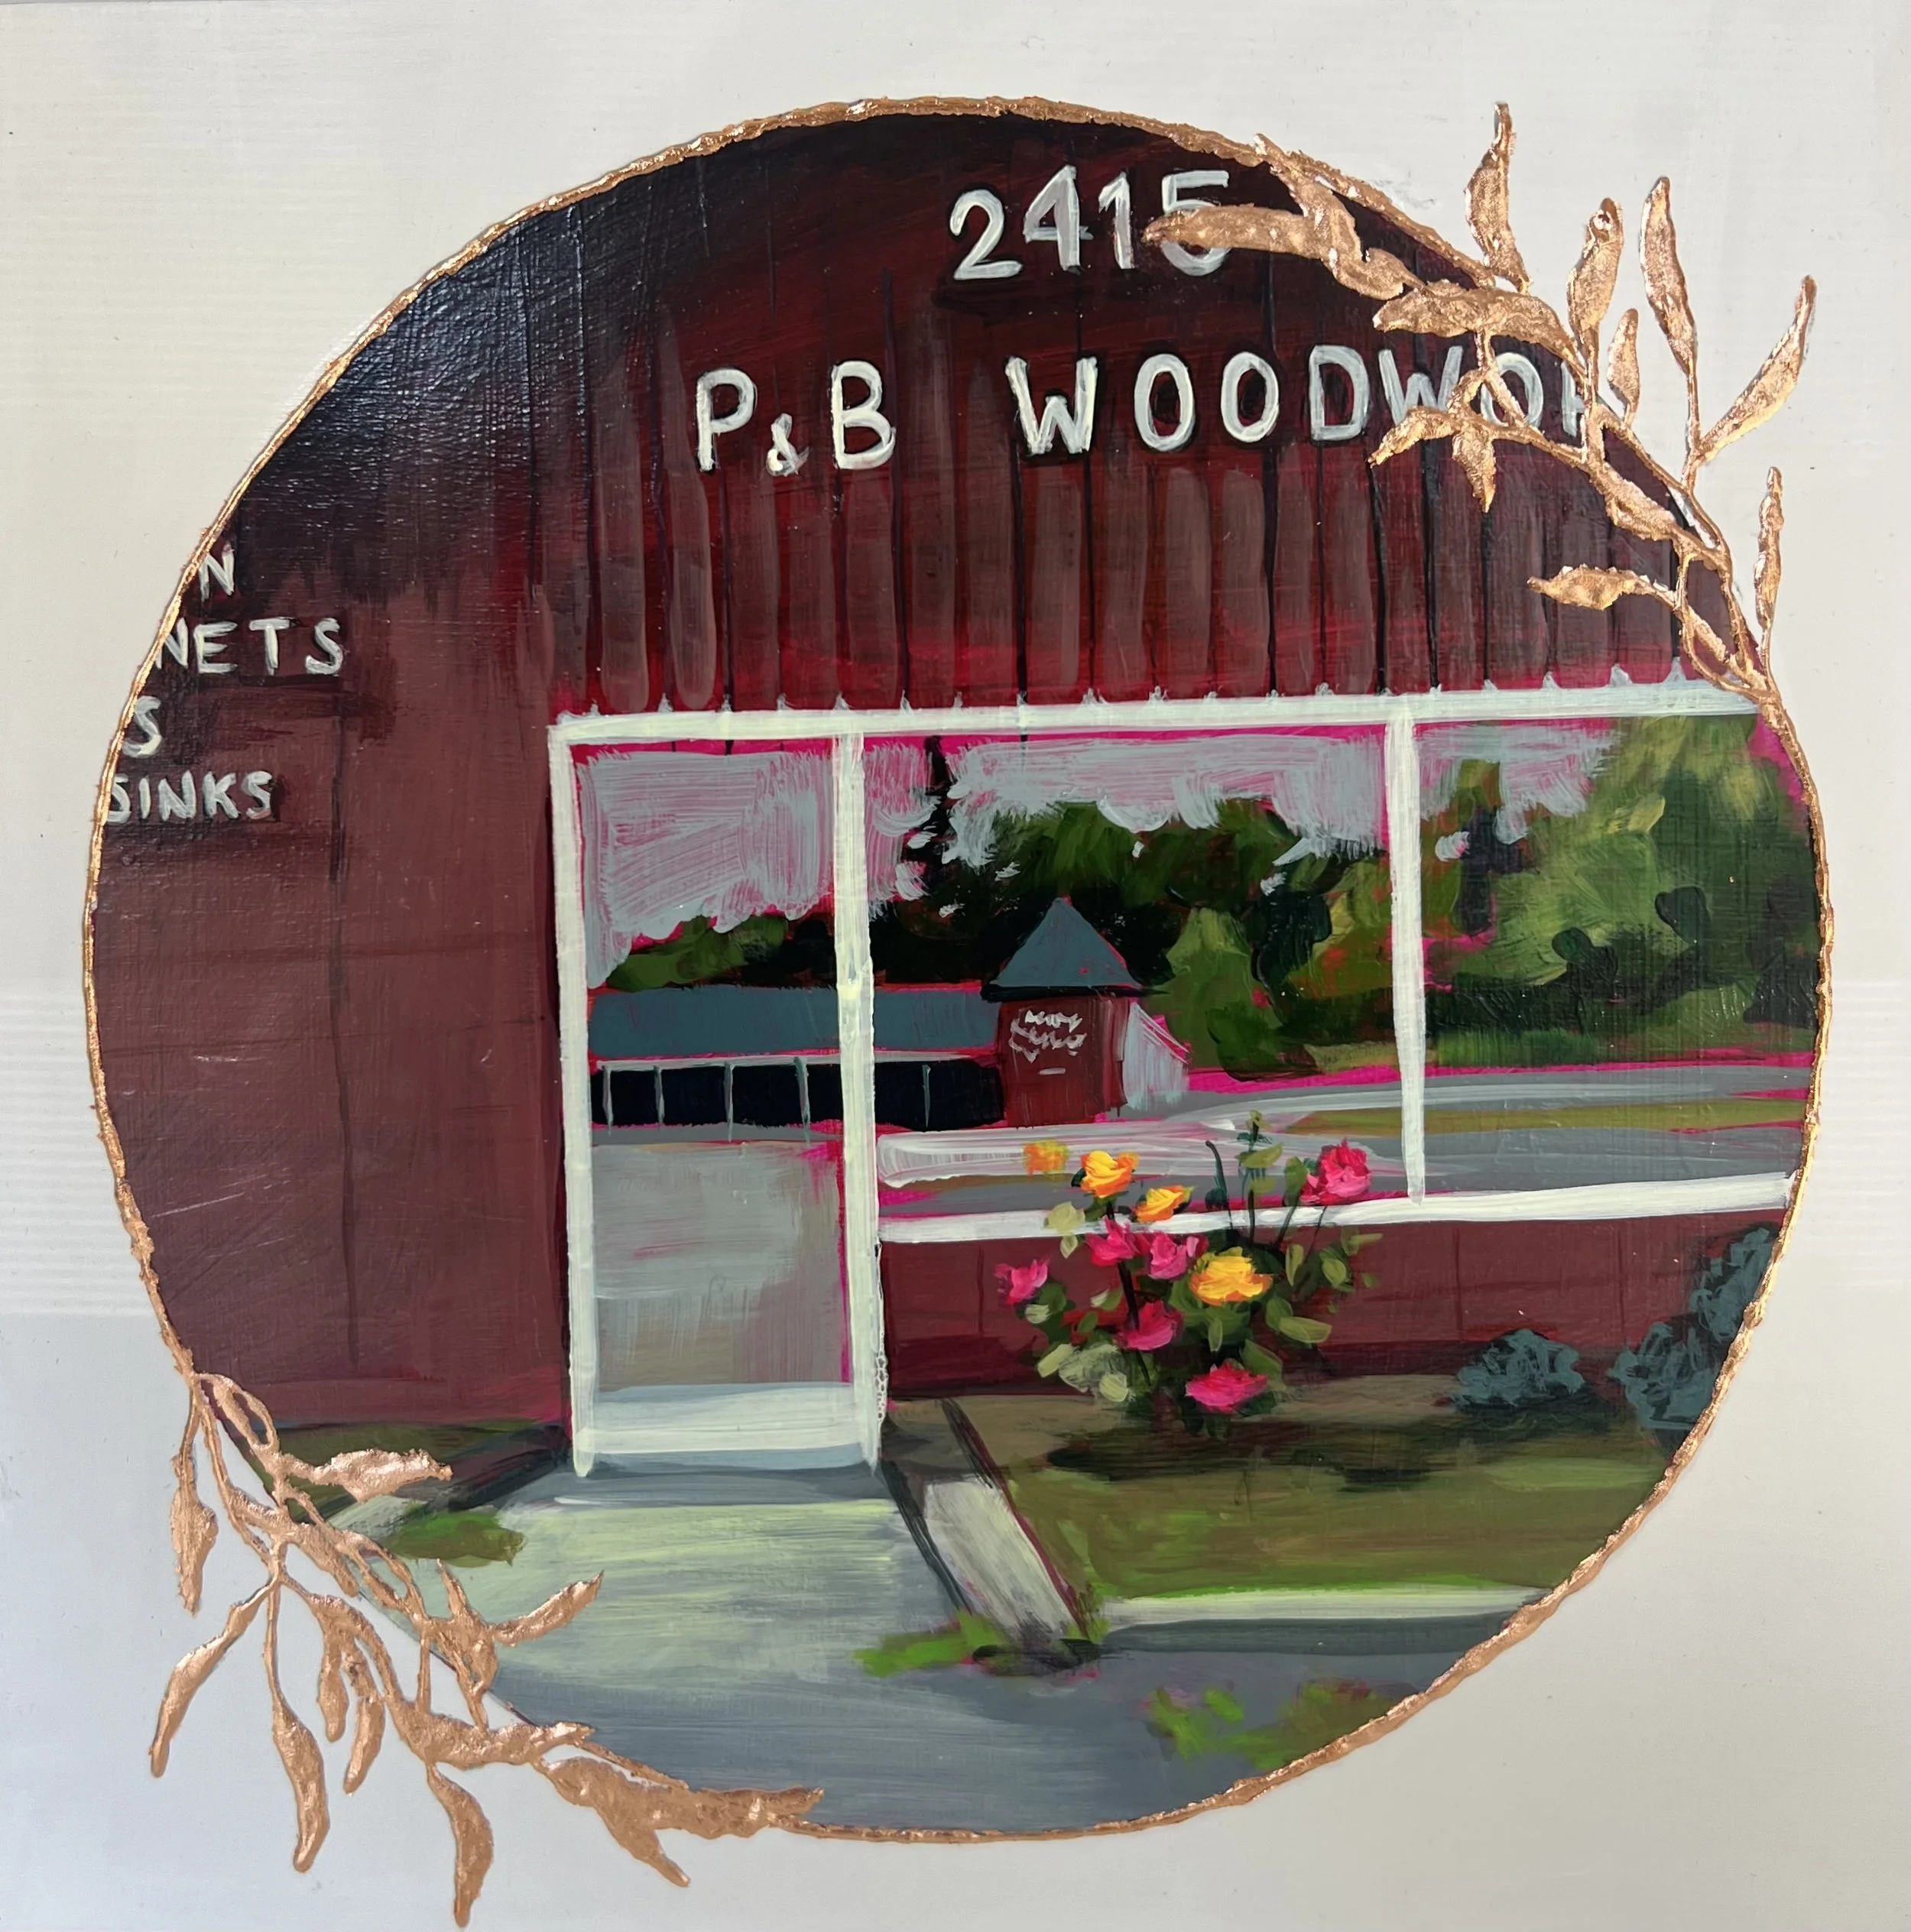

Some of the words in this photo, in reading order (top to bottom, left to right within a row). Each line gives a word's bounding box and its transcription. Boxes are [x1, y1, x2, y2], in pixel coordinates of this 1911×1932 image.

[949, 164, 1231, 280] 2415
[692, 368, 757, 472] P
[766, 413, 809, 477] &
[831, 360, 896, 469] B
[155, 617, 345, 676] NETS
[106, 770, 274, 824] SINKS
